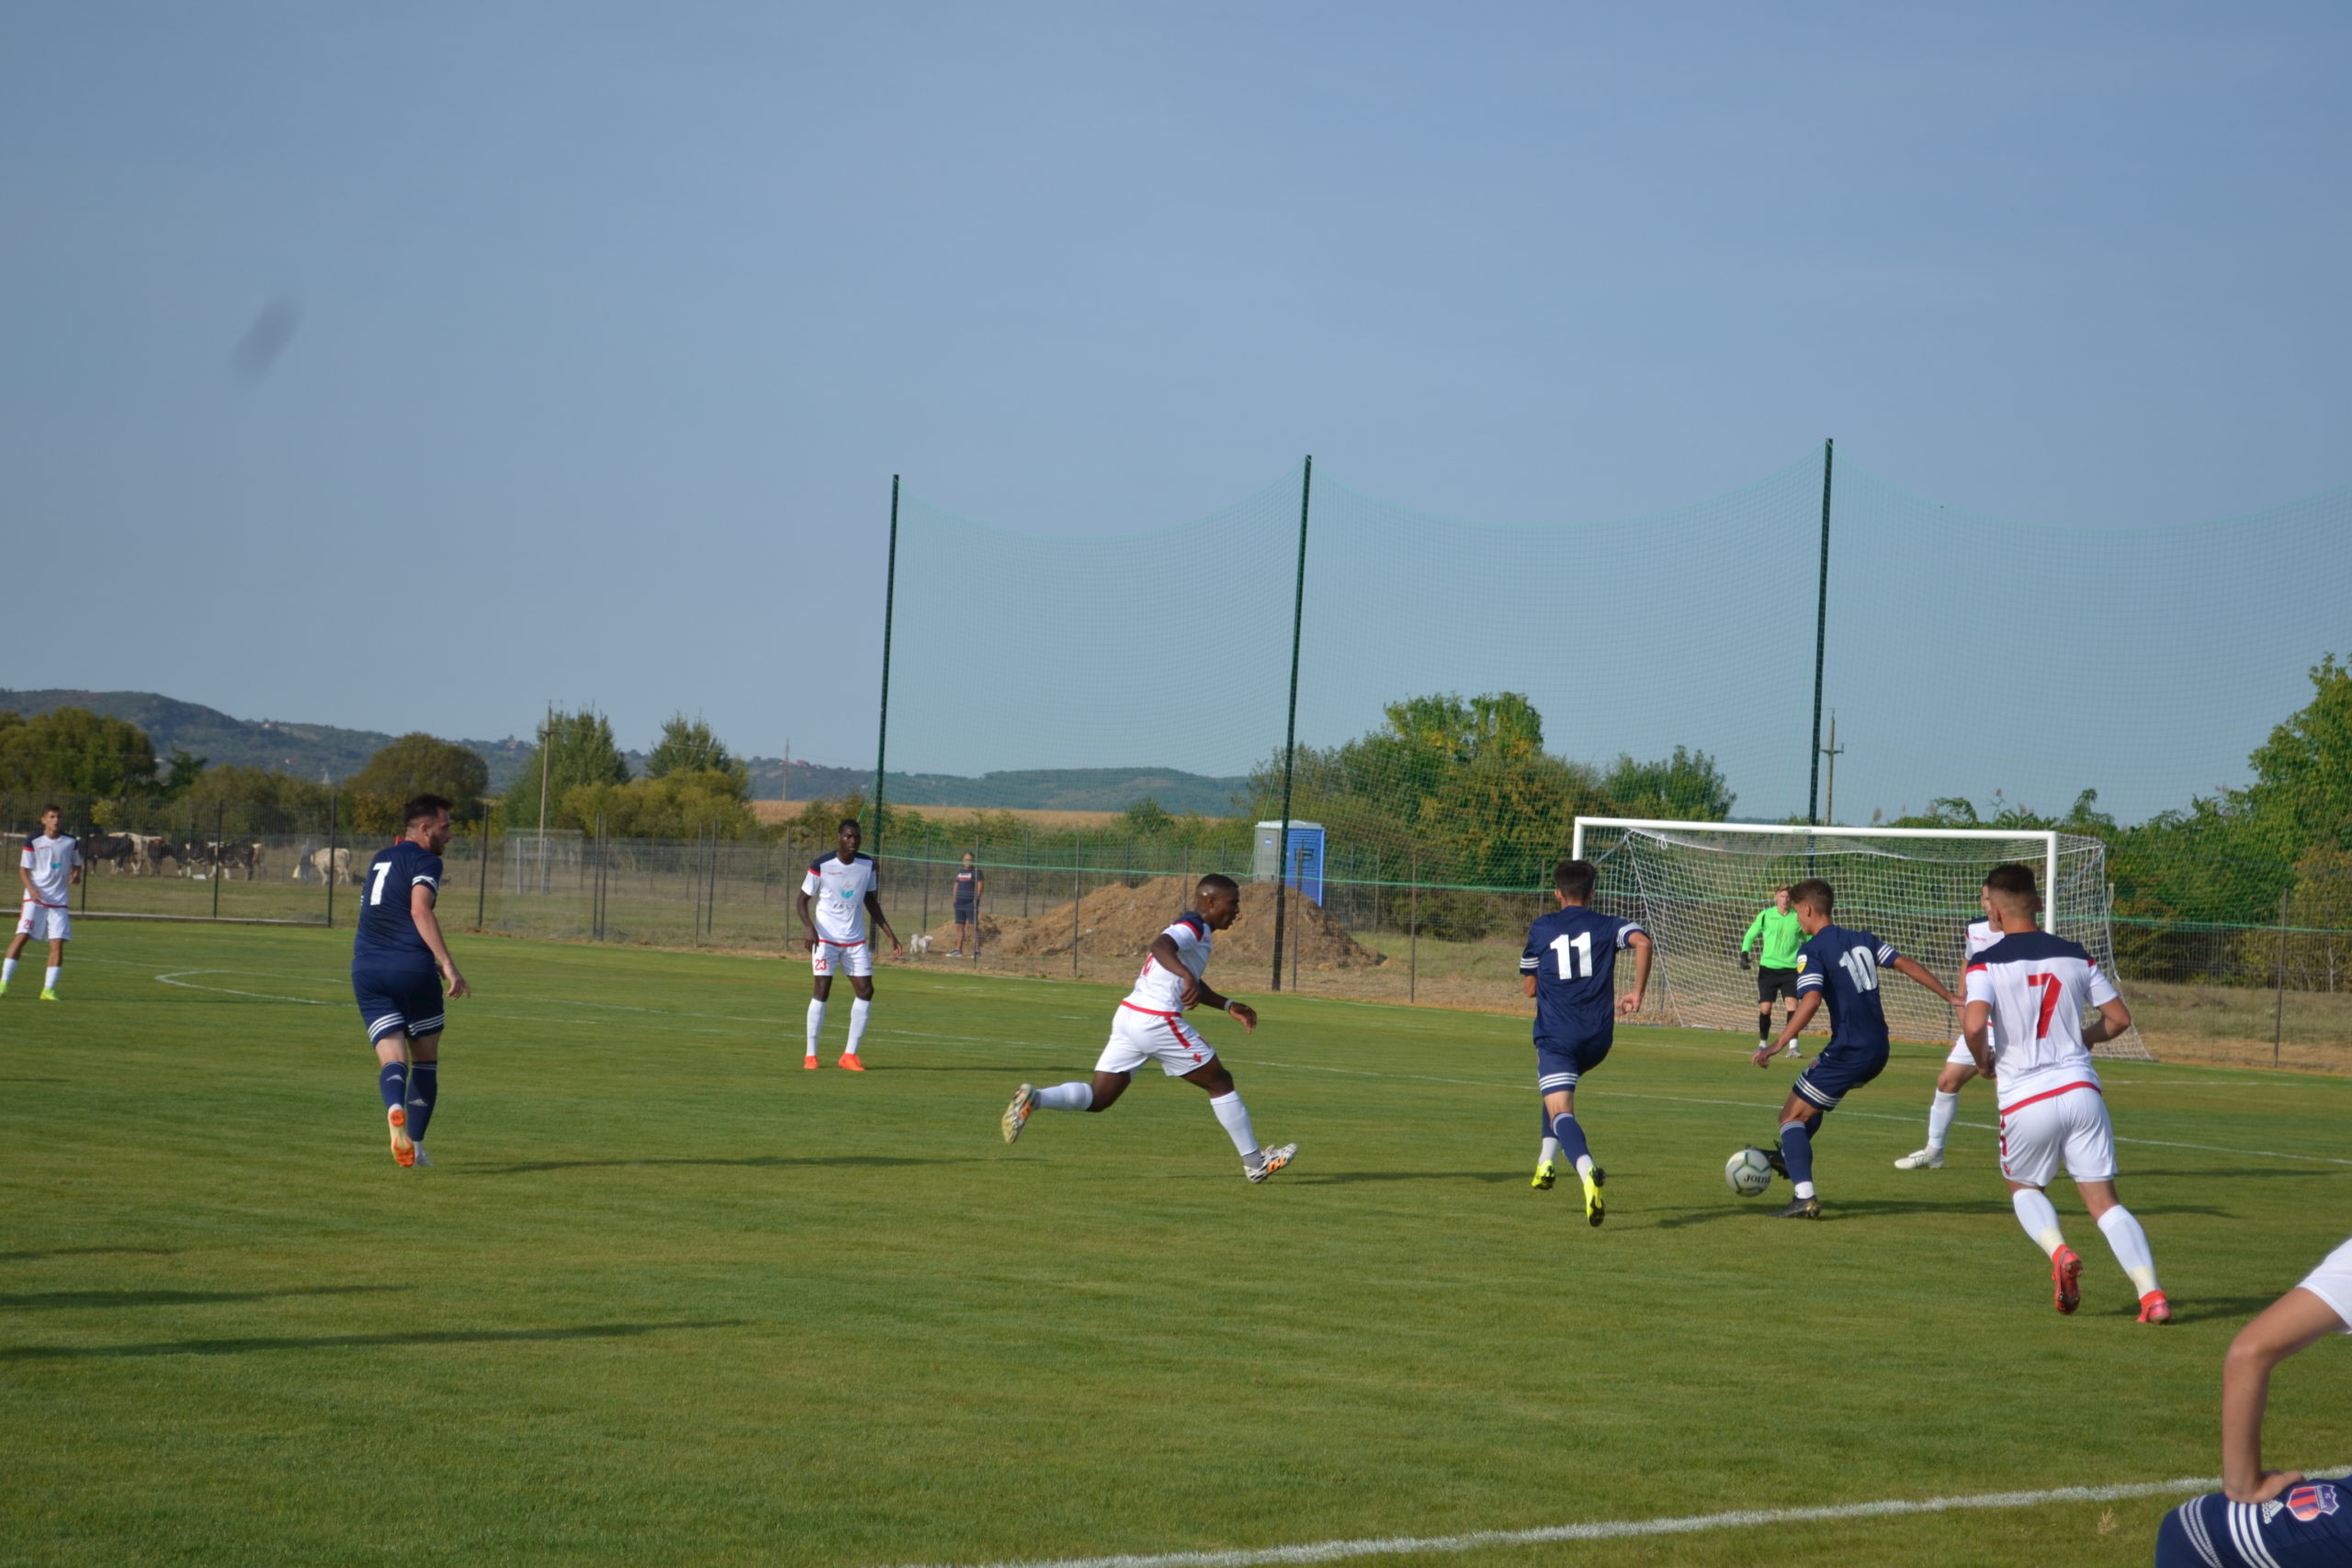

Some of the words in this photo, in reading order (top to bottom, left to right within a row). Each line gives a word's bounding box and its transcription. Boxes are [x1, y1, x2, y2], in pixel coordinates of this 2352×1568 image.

[814, 958, 828, 971] 23
[1550, 931, 1593, 980] 11
[1838, 945, 1878, 994] 10
[2028, 972, 2062, 1039] 7
